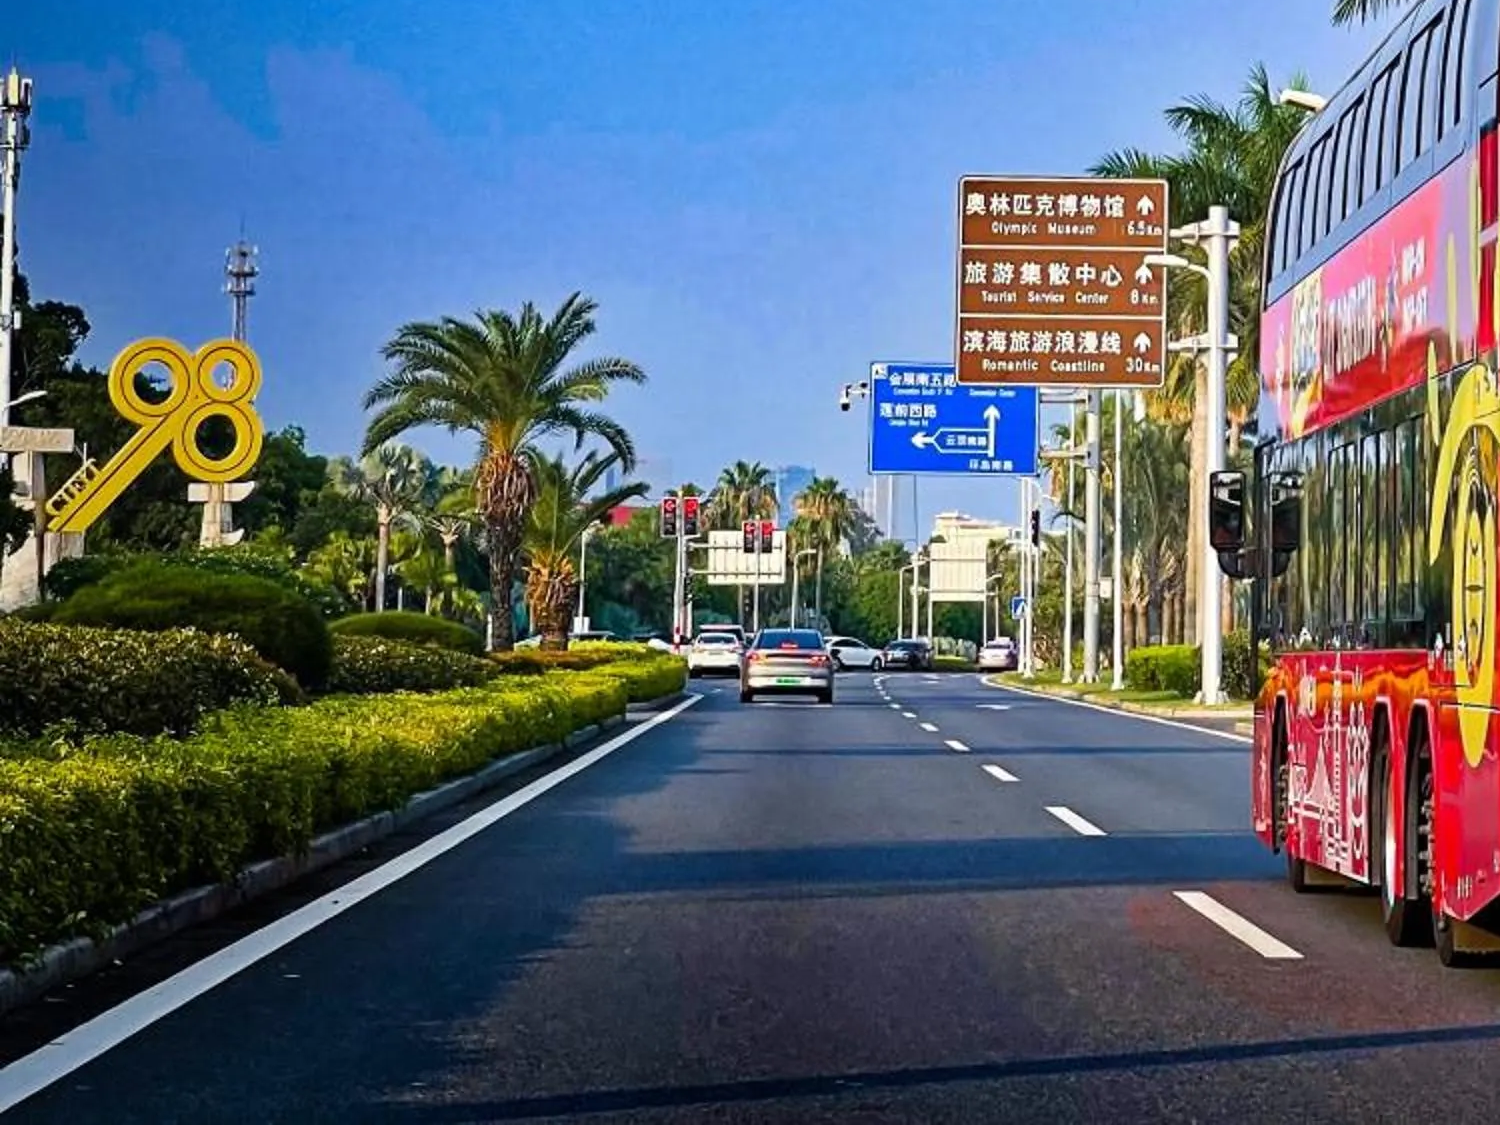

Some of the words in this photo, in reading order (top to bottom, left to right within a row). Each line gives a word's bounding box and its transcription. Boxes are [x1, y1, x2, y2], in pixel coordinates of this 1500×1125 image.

[965, 192, 1125, 218] 奥林匹克博物馆
[991, 221, 1037, 235] Olympic
[1047, 222, 1096, 235] Museum
[964, 260, 1123, 287] 旅游集散中心
[981, 290, 1017, 303] Tourist
[1027, 290, 1065, 303] Service
[1075, 290, 1109, 303] Center
[963, 330, 1122, 354] 滨海旅游浪漫线
[982, 358, 1039, 372] Romantic
[1050, 359, 1105, 372] Coastline
